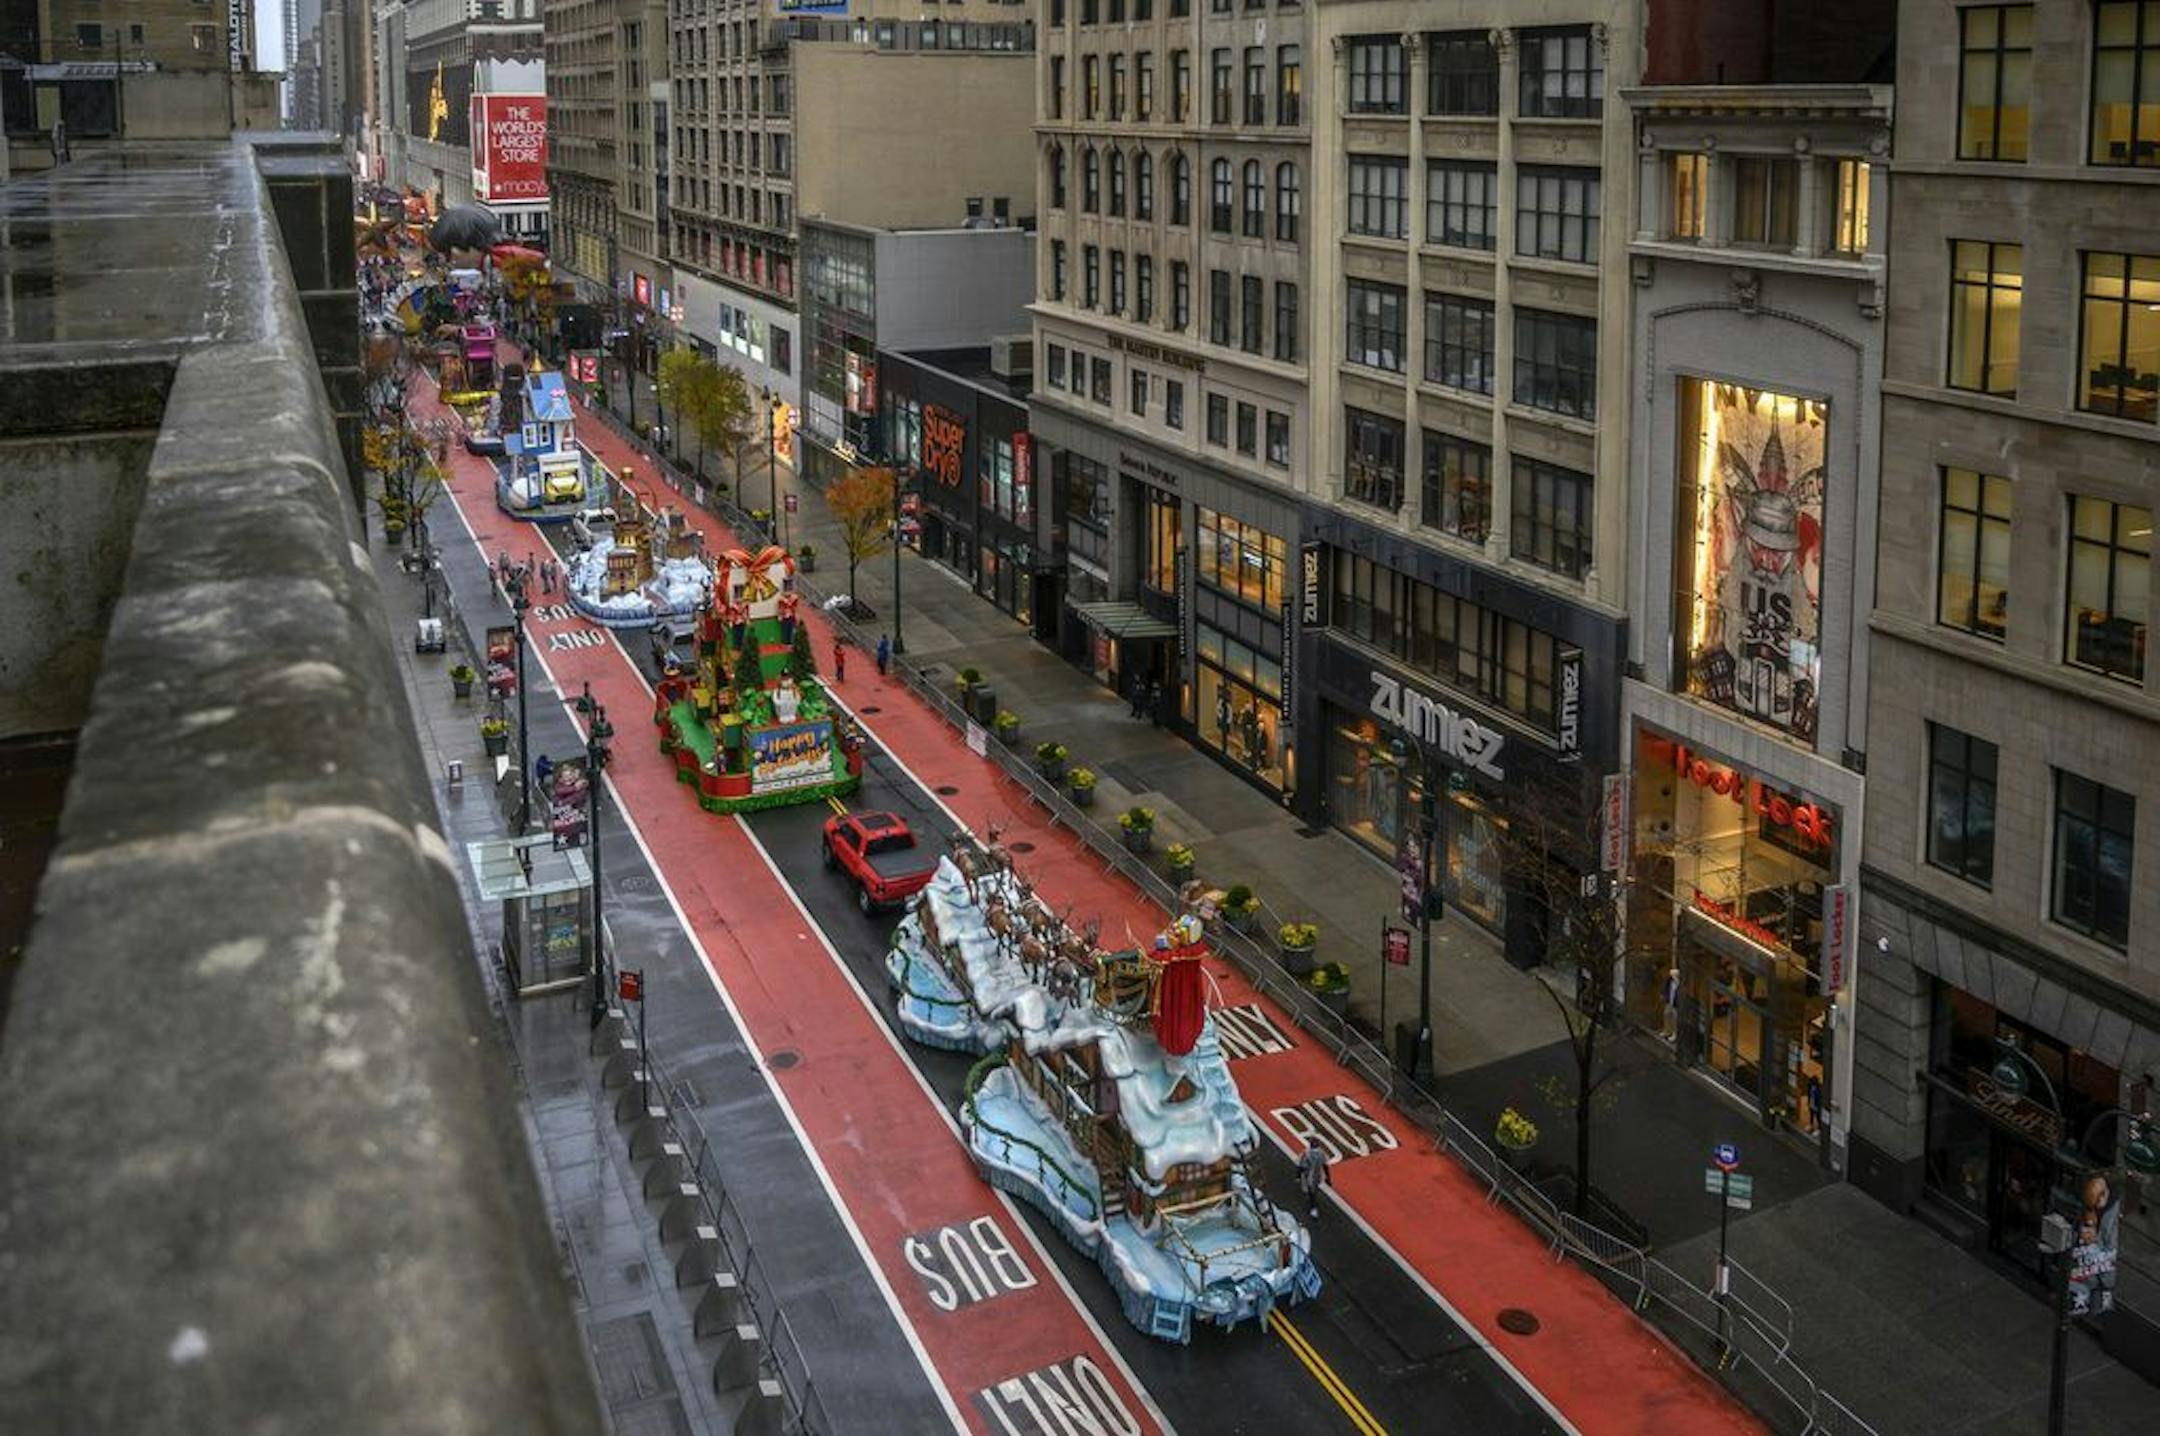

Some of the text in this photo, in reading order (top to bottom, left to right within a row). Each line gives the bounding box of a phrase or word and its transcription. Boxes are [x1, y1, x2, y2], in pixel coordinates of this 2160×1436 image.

[507, 106, 532, 121] THE
[492, 135, 544, 149] LARGEST
[501, 149, 539, 164] STORE
[922, 403, 965, 454] Super
[550, 626, 606, 653] ONLY
[1210, 1004, 1294, 1061] NLY
[1270, 1095, 1398, 1166] BUS
[904, 1215, 1039, 1311] BUS
